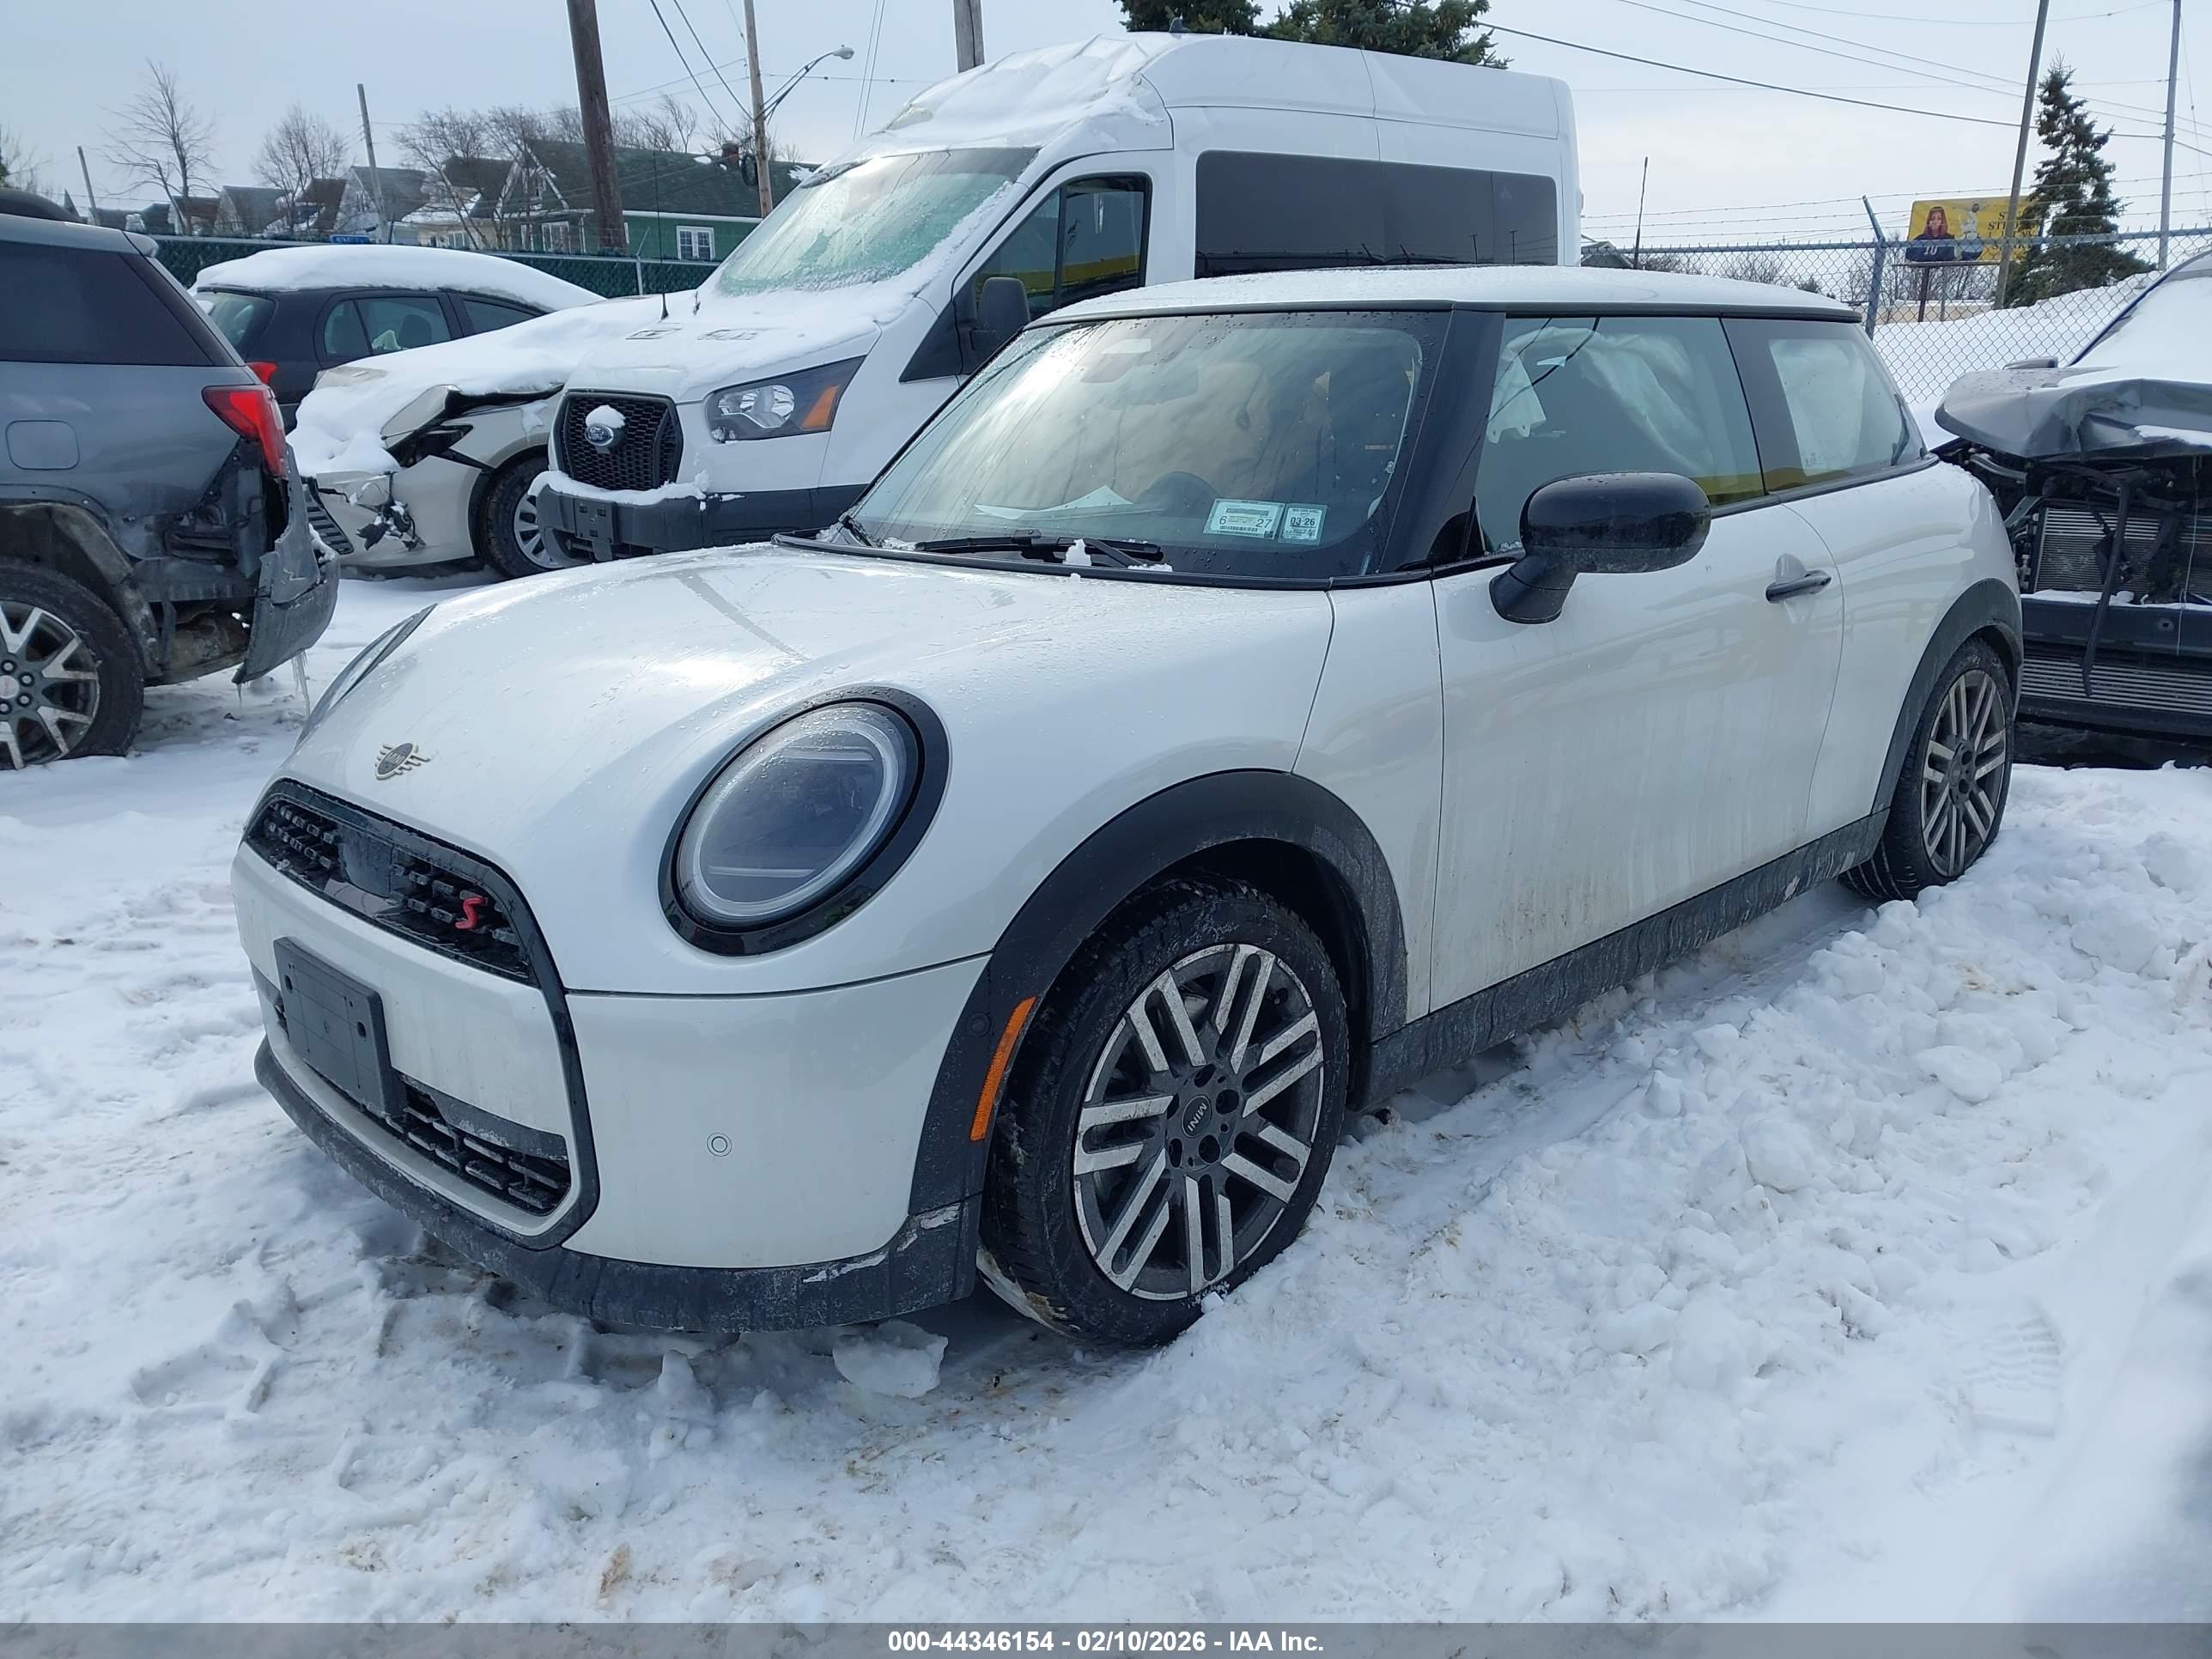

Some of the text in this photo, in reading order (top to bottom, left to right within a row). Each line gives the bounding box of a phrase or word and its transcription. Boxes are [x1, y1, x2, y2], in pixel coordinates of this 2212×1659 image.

[1219, 515, 1227, 525] 6
[1255, 518, 1273, 528] 27
[455, 896, 484, 929] S
[1187, 1102, 1207, 1132] MINI
